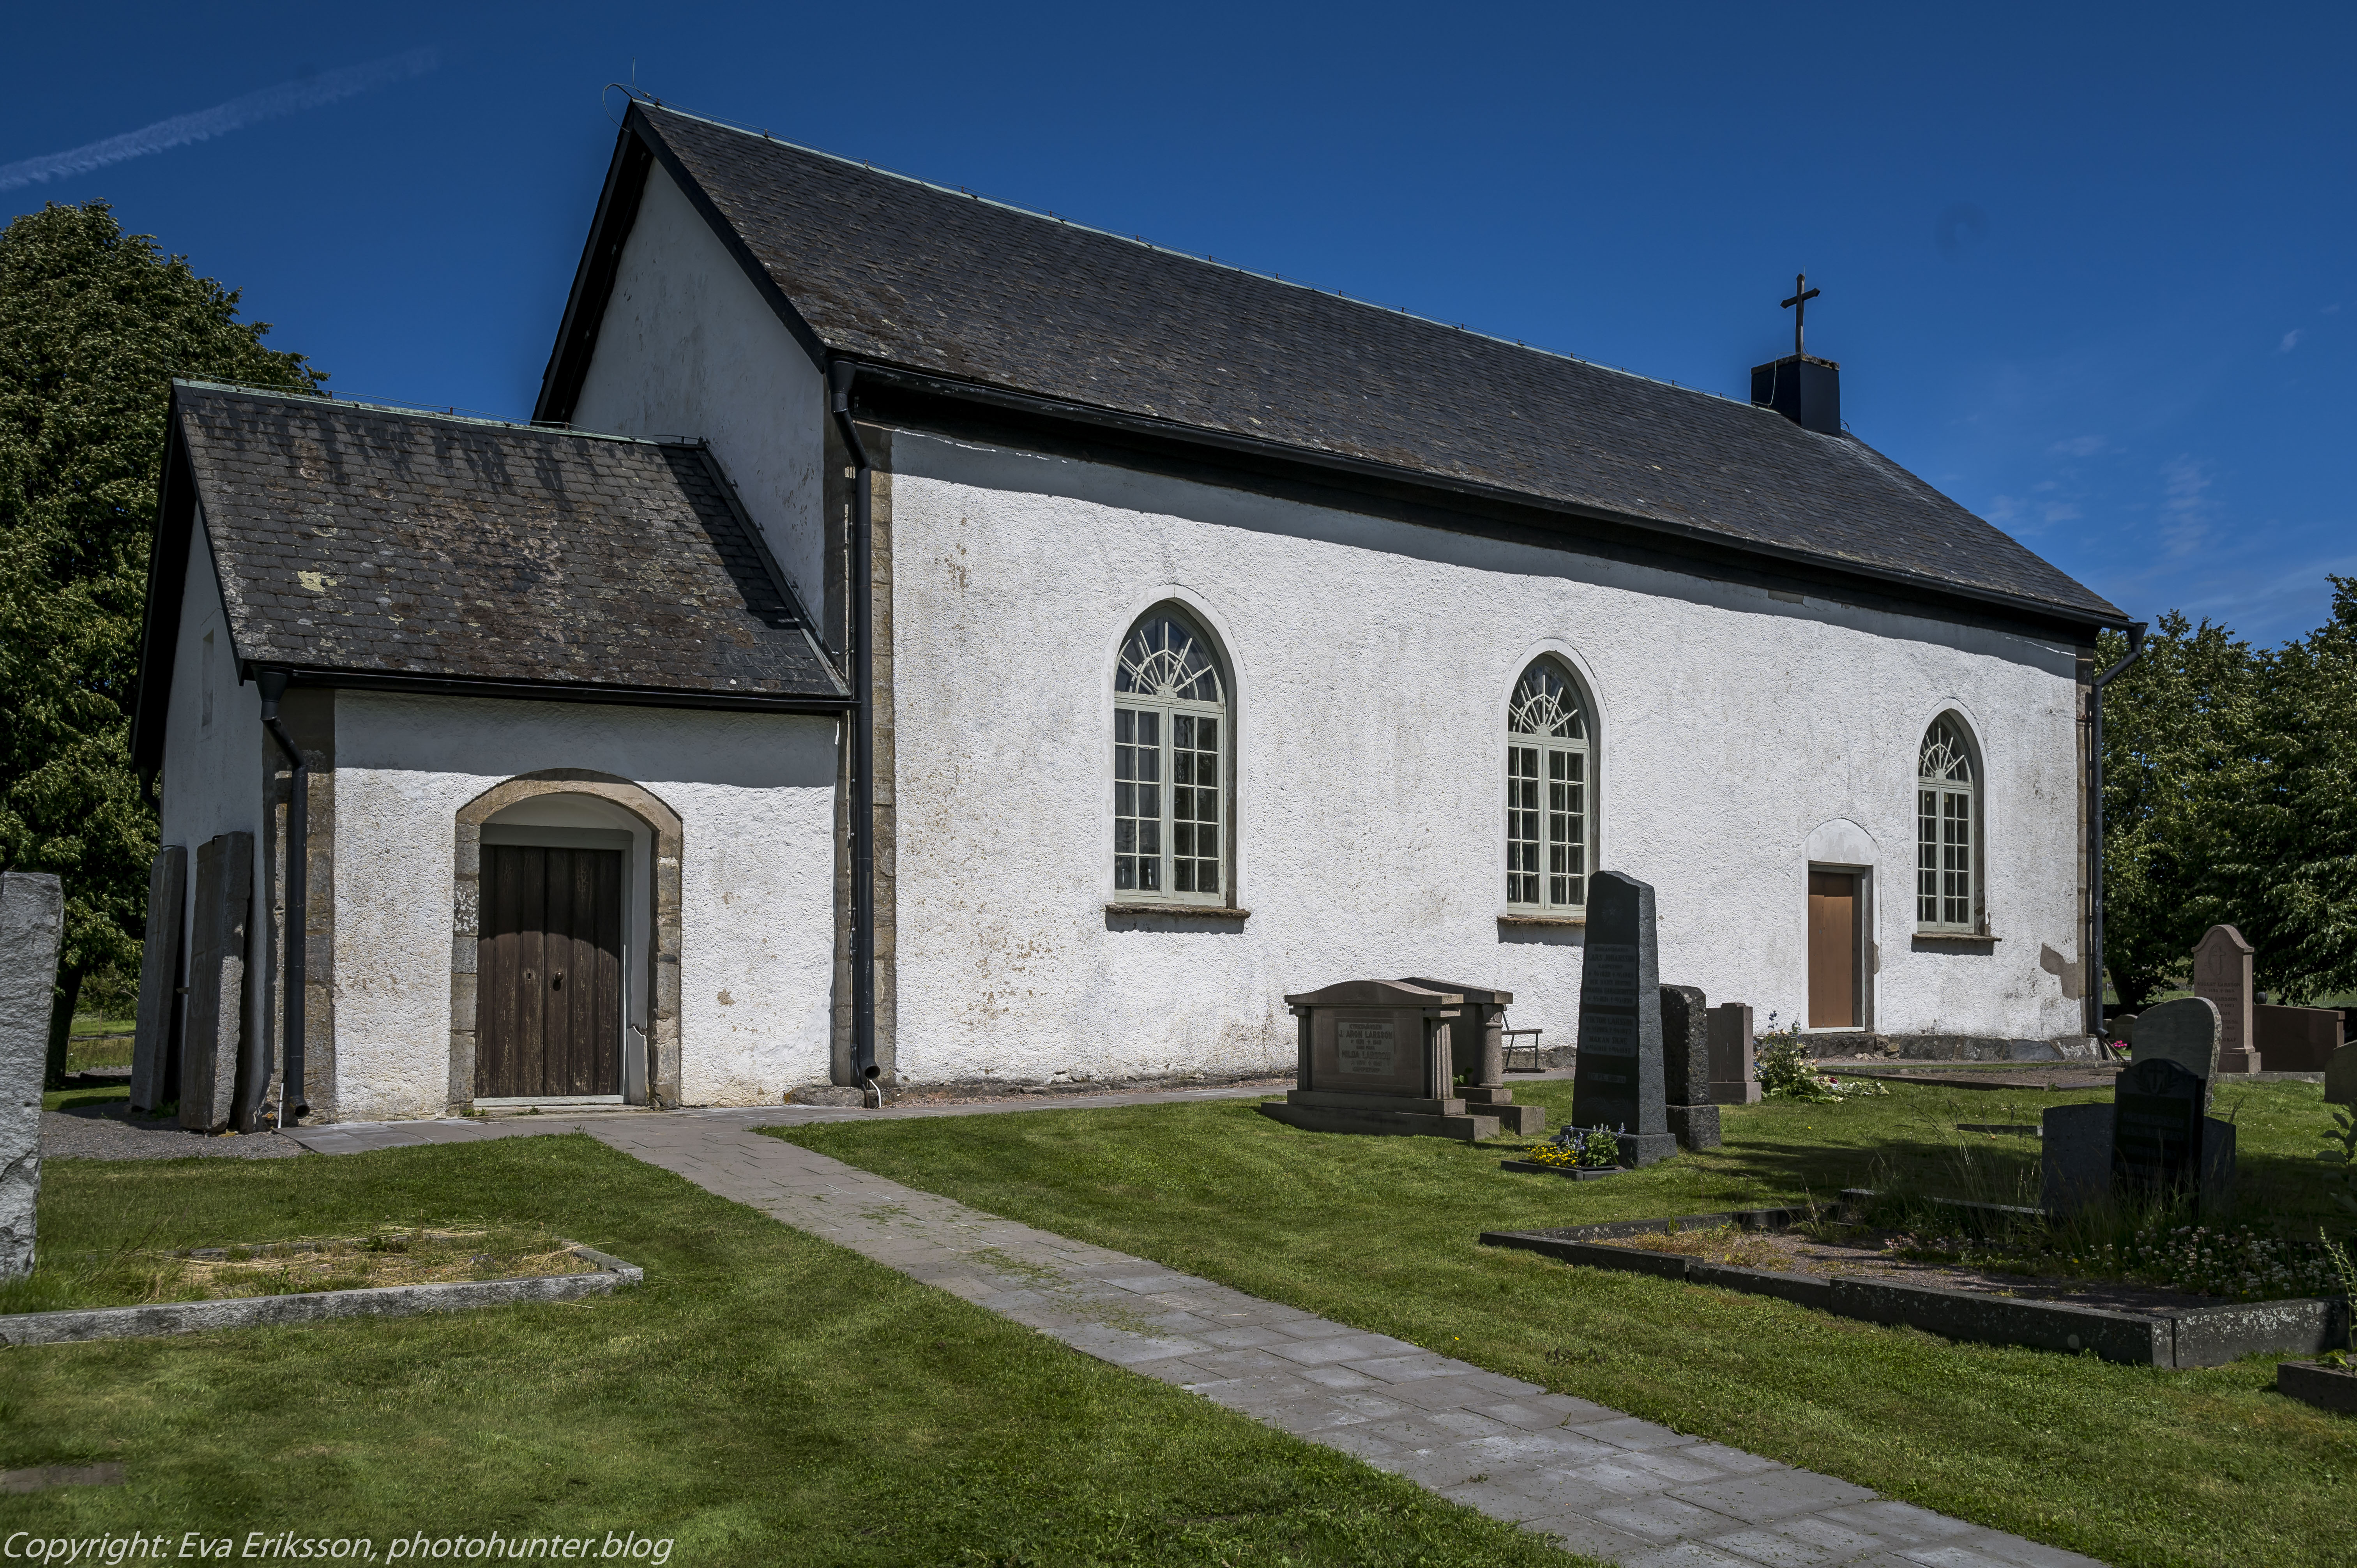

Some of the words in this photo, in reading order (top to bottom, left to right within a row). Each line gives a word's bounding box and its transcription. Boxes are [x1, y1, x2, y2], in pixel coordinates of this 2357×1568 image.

[1604, 954, 1635, 962] JOHANSSON
[1585, 1015, 1606, 1024] VIKTOR
[1608, 1017, 1633, 1026] LARSSON
[1346, 1030, 1362, 1038] ARON
[1365, 1031, 1393, 1039] LARSSON
[1589, 1035, 1610, 1044] MAKAN
[1342, 1050, 1360, 1058] HILDA
